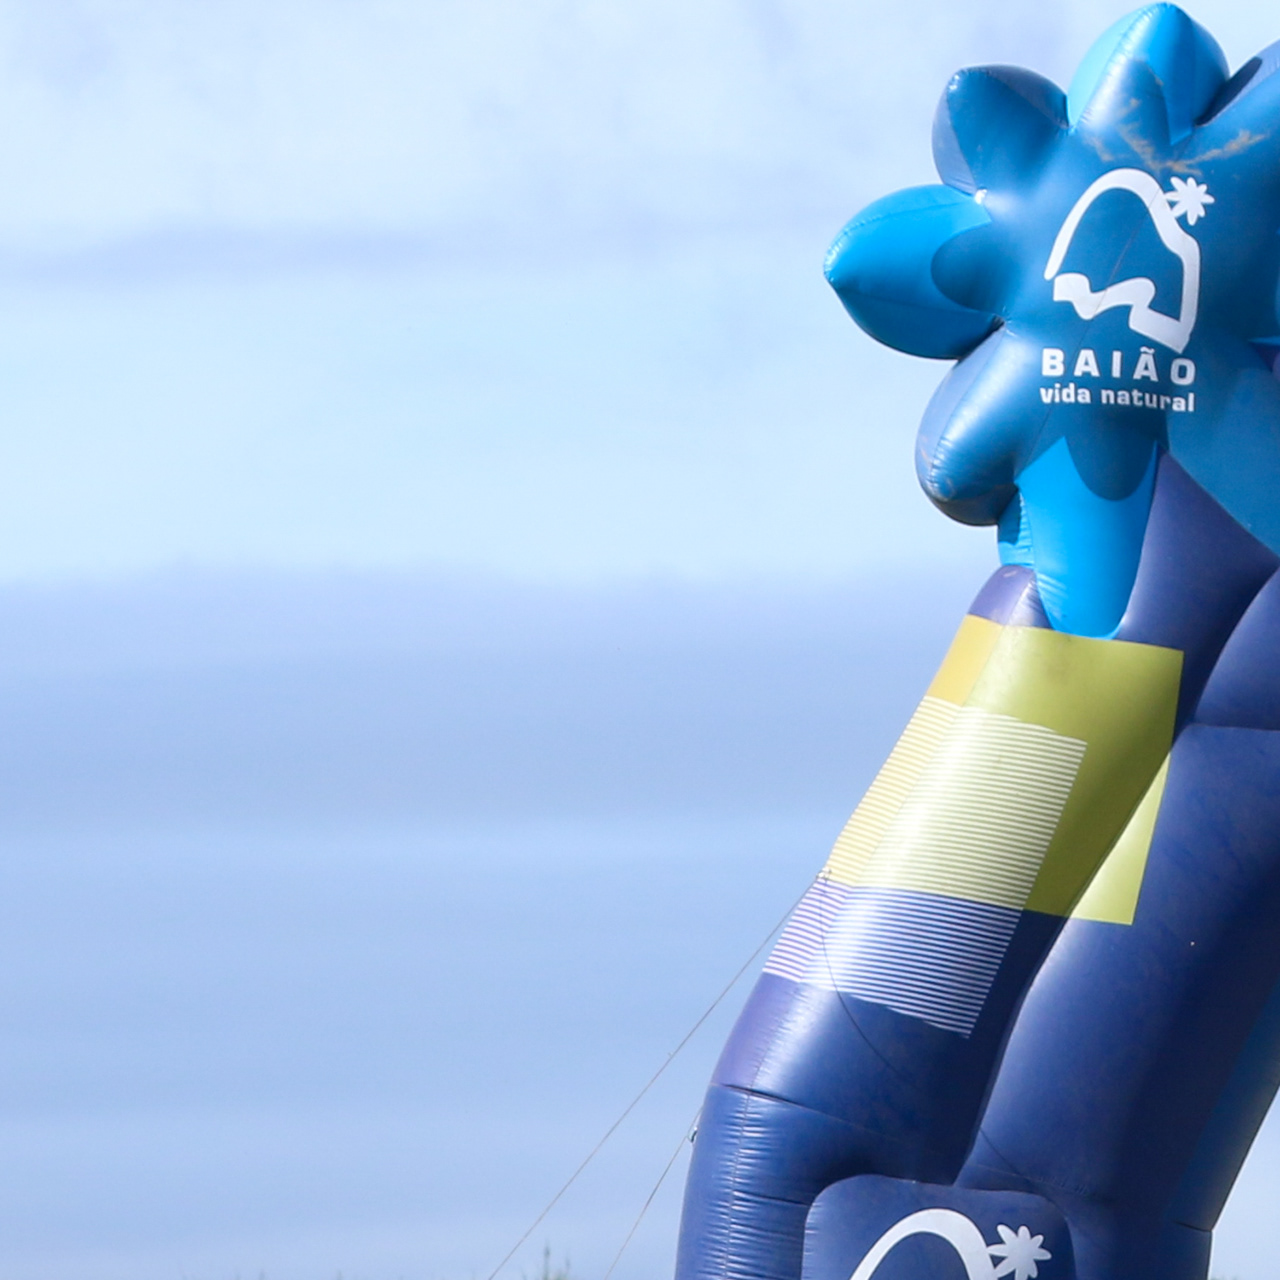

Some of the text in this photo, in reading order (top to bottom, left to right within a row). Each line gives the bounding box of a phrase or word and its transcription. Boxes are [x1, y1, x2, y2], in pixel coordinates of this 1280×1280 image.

[1042, 346, 1196, 386] BAIÃO
[1040, 382, 1195, 412] vida natural
